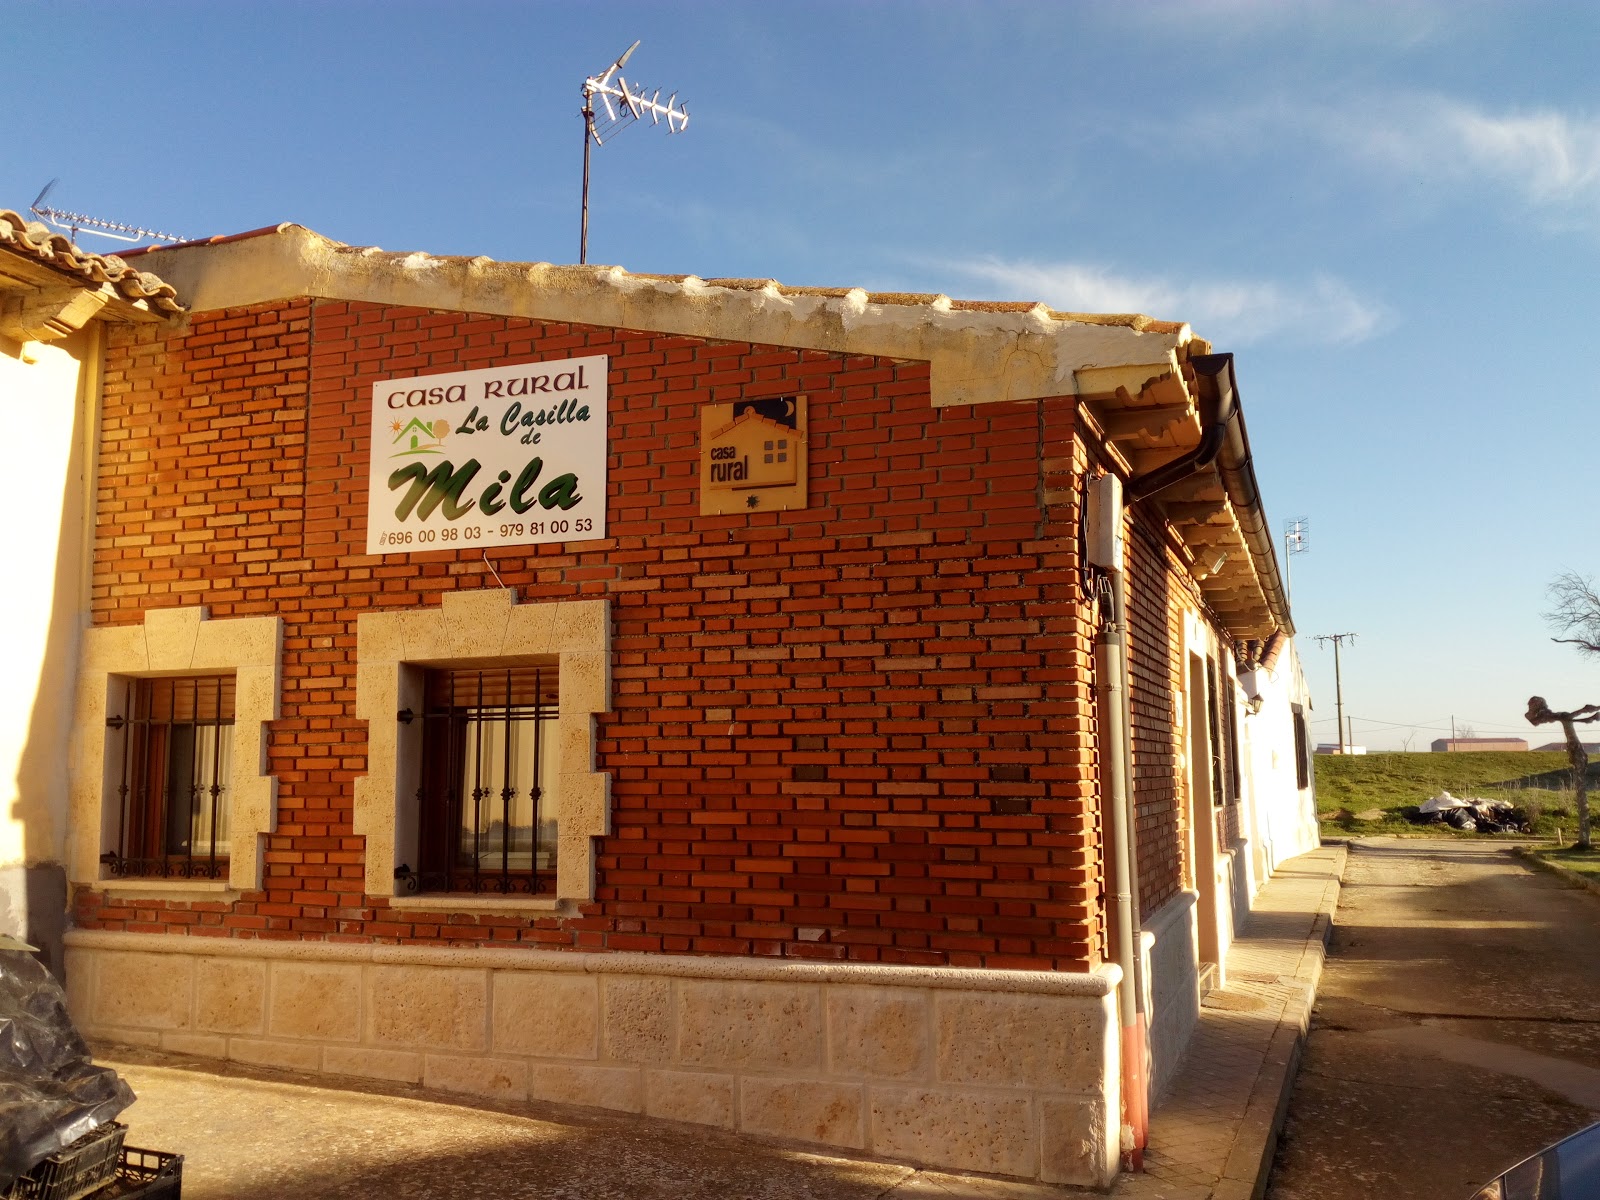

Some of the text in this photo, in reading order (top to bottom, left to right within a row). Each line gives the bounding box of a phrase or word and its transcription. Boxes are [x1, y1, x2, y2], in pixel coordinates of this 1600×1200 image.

[455, 398, 591, 436] La Casilla
[520, 427, 541, 445] de
[710, 446, 736, 460] casa
[710, 455, 748, 482] rural
[387, 456, 583, 522] Mila
[388, 531, 413, 545] 696
[418, 529, 436, 543] 00
[441, 528, 458, 541] 98
[464, 526, 481, 540] 03
[500, 523, 524, 537] 979
[530, 522, 544, 535] 81
[550, 520, 569, 533] 00
[575, 518, 593, 532] 53
